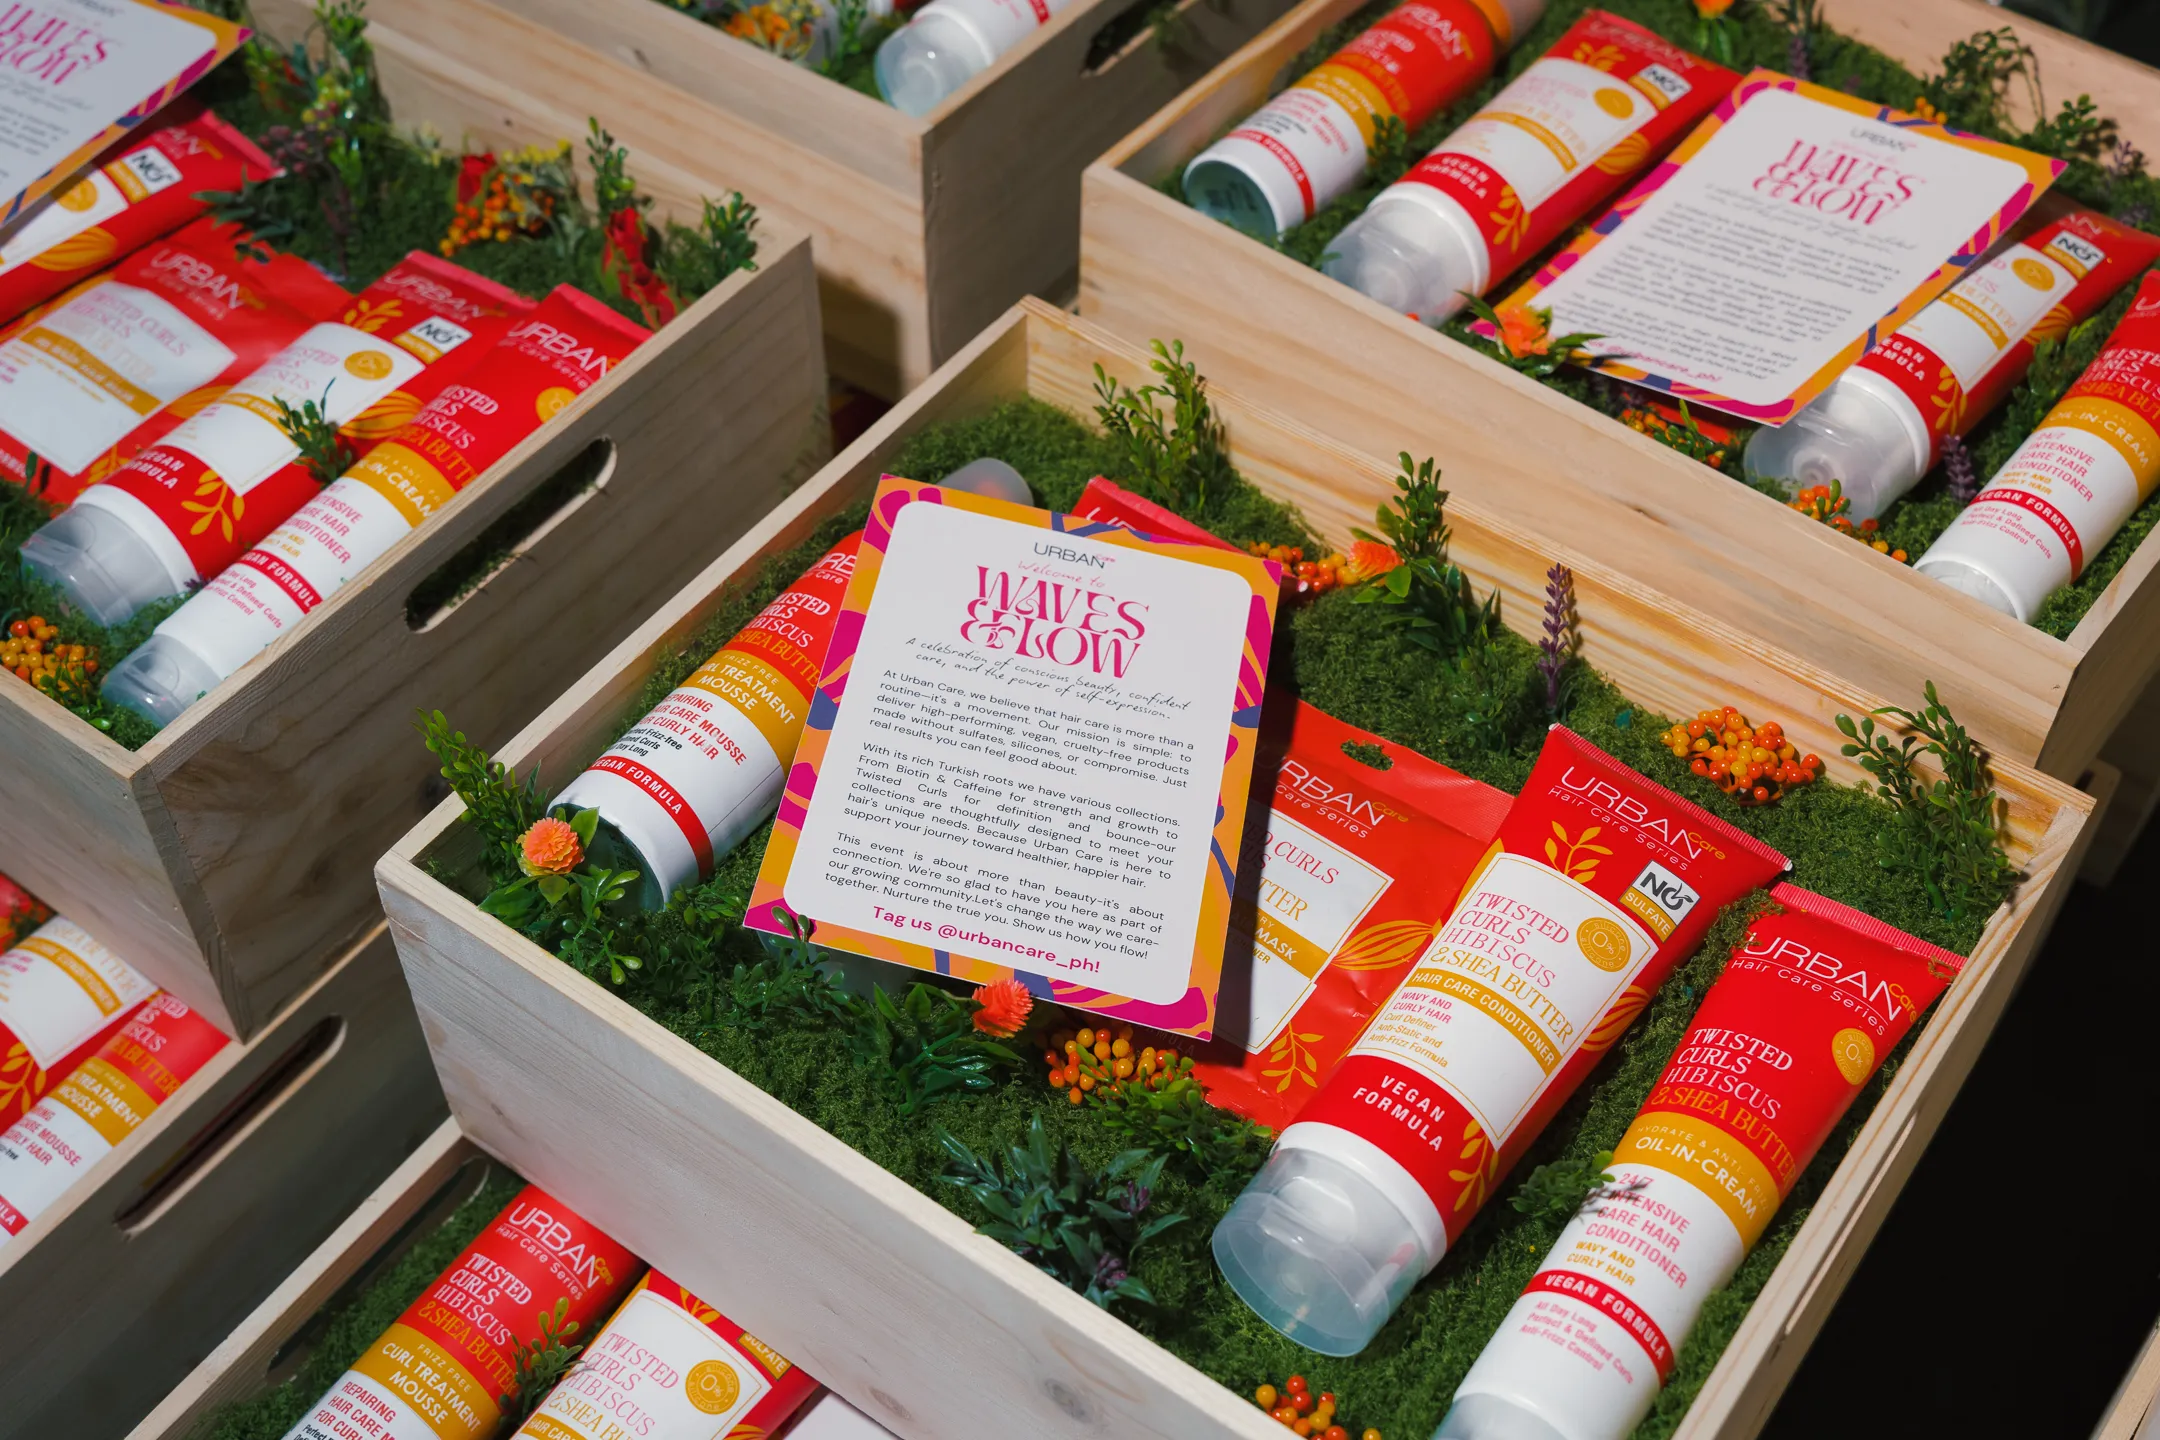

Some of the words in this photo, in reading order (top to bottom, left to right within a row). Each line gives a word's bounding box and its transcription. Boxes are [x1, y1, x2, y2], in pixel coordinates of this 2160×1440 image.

[1881, 337, 1925, 364] EGAN
[2019, 451, 2052, 462] CARE
[2056, 455, 2089, 478] HAIR
[2027, 440, 2097, 467] INTENSIVE
[2025, 496, 2077, 549] FORMULA
[815, 570, 844, 585] Care
[1017, 560, 1083, 584] Welcome
[1089, 575, 1106, 589] to
[1033, 541, 1106, 570] URBAN
[976, 564, 1150, 641] WAVES
[724, 654, 752, 668] FRIZZ
[752, 664, 780, 686] FREE
[770, 637, 821, 688] BUTTE
[905, 637, 917, 645] A
[920, 642, 988, 666] celebration
[989, 658, 1012, 672] of
[1014, 665, 1069, 683] conscious
[1075, 675, 1121, 698] beauty,
[1128, 692, 1192, 711] confident
[915, 653, 946, 668] care,
[954, 663, 984, 673] and
[984, 667, 1005, 680] the
[1007, 677, 1050, 689] power
[1054, 685, 1073, 697] of
[1075, 690, 1171, 720] self-expression.
[697, 674, 758, 711] MOUSSE
[719, 663, 796, 725] TREATMENT
[883, 669, 898, 680] At
[900, 673, 935, 689] Urban
[937, 682, 966, 697] Care,
[970, 691, 987, 701] we
[989, 694, 1031, 712] believe
[1034, 706, 1057, 718] that
[1059, 711, 1082, 724] hair
[1084, 719, 1110, 731] care
[1112, 724, 1122, 734] is
[1125, 729, 1156, 742] more
[1158, 735, 1184, 748] than
[1186, 743, 1194, 751] a
[653, 716, 692, 736] CURLY
[687, 732, 719, 761] HAIR
[668, 705, 702, 724] CARE
[698, 718, 748, 766] MOUSSE
[879, 682, 947, 705] routine—it's
[967, 704, 1031, 725] movement.
[1038, 719, 1061, 731] Our
[1066, 728, 1110, 744] mission
[1116, 737, 1126, 748] is
[1132, 743, 1173, 759] simple:
[1180, 753, 1192, 763] to
[625, 765, 685, 815] FORMULA
[1275, 783, 1312, 810] Care
[1316, 805, 1369, 839] Series
[1371, 801, 1409, 823] Care
[1561, 766, 1702, 860] URBAN
[1687, 831, 1726, 860] Care
[1547, 787, 1585, 807] Hair
[1590, 807, 1629, 834] Care
[1634, 833, 1689, 871] Series
[1274, 840, 1340, 886] CURLS
[1625, 891, 1672, 936] SULFATE
[1639, 871, 1686, 911] NO
[873, 905, 907, 928] Tag
[910, 918, 933, 932] us
[937, 924, 1101, 974] @urbancare_ph!
[1458, 910, 1531, 945] CURLS
[1473, 892, 1570, 944] TWISTED
[1255, 927, 1298, 961] MASK
[1442, 927, 1557, 989] HIBISCUS
[1592, 931, 1615, 955] 0%
[1400, 991, 1429, 1006] WAVY
[1428, 996, 1453, 1010] AND
[1730, 959, 1771, 973] Hair
[1777, 968, 1823, 993] Care
[1829, 990, 1885, 1036] Series
[1743, 931, 1902, 1022] URBAN
[1888, 982, 1918, 1023] Care
[1383, 1012, 1403, 1022] Curl
[1403, 1015, 1439, 1032] Definer
[1392, 1002, 1425, 1013] CURLY
[1425, 1008, 1452, 1025] HAIR
[1412, 972, 1442, 985] HAIR
[1442, 978, 1481, 1000] CARE
[1479, 993, 1555, 1066] CONDITIONER
[1500, 972, 1574, 1045] BUTTER
[1367, 1033, 1409, 1048] Anti-Frizz
[1409, 1043, 1449, 1069] Formula
[1375, 1023, 1422, 1040] Anti-Static
[1422, 1036, 1444, 1049] and
[1689, 1027, 1793, 1072] TWISTED
[1676, 1047, 1753, 1075] CURLS
[1380, 1075, 1446, 1123] VEGAN
[1663, 1066, 1782, 1121] HIBISCUS
[1352, 1087, 1444, 1152] FORMULA
[1637, 1125, 1695, 1142] HYDRATE
[1698, 1139, 1708, 1148] &
[26, 1141, 54, 1167] HAIR
[37, 1123, 82, 1168] MOUSSE
[1730, 1107, 1798, 1189] BUTTER
[1635, 1135, 1758, 1220] OIL-IN-CREAM
[1596, 1205, 1641, 1228] CARE
[1641, 1221, 1682, 1254] HAIR
[1607, 1190, 1692, 1235] INTENSIVE
[495, 1226, 516, 1241] Hair
[519, 1237, 549, 1263] Care
[549, 1262, 584, 1301] Series
[508, 1202, 600, 1289] URBAN
[1566, 1253, 1605, 1269] CURLY
[1605, 1264, 1636, 1287] HAIR
[1575, 1240, 1609, 1255] WAVY
[1608, 1249, 1636, 1269] AND
[1585, 1222, 1689, 1290] CONDITIONER
[449, 1268, 501, 1306] CURLS
[464, 1252, 533, 1305] TWISTED
[433, 1283, 512, 1346] HIBISCUS
[1544, 1274, 1600, 1299] VEGAN
[1601, 1291, 1667, 1361] FORMULA
[417, 1343, 447, 1369] FRIZZ
[447, 1367, 472, 1394] FREE
[583, 1351, 643, 1393] CURLS
[600, 1331, 680, 1390] TWISTED
[341, 1380, 398, 1424] REPAIRING
[381, 1342, 411, 1369] CURL
[413, 1360, 482, 1433] TREATMENT
[388, 1370, 449, 1425] MOUSSE
[565, 1371, 656, 1437] HIBISCUS
[327, 1394, 354, 1415] HAIR
[350, 1407, 384, 1438] CARE
